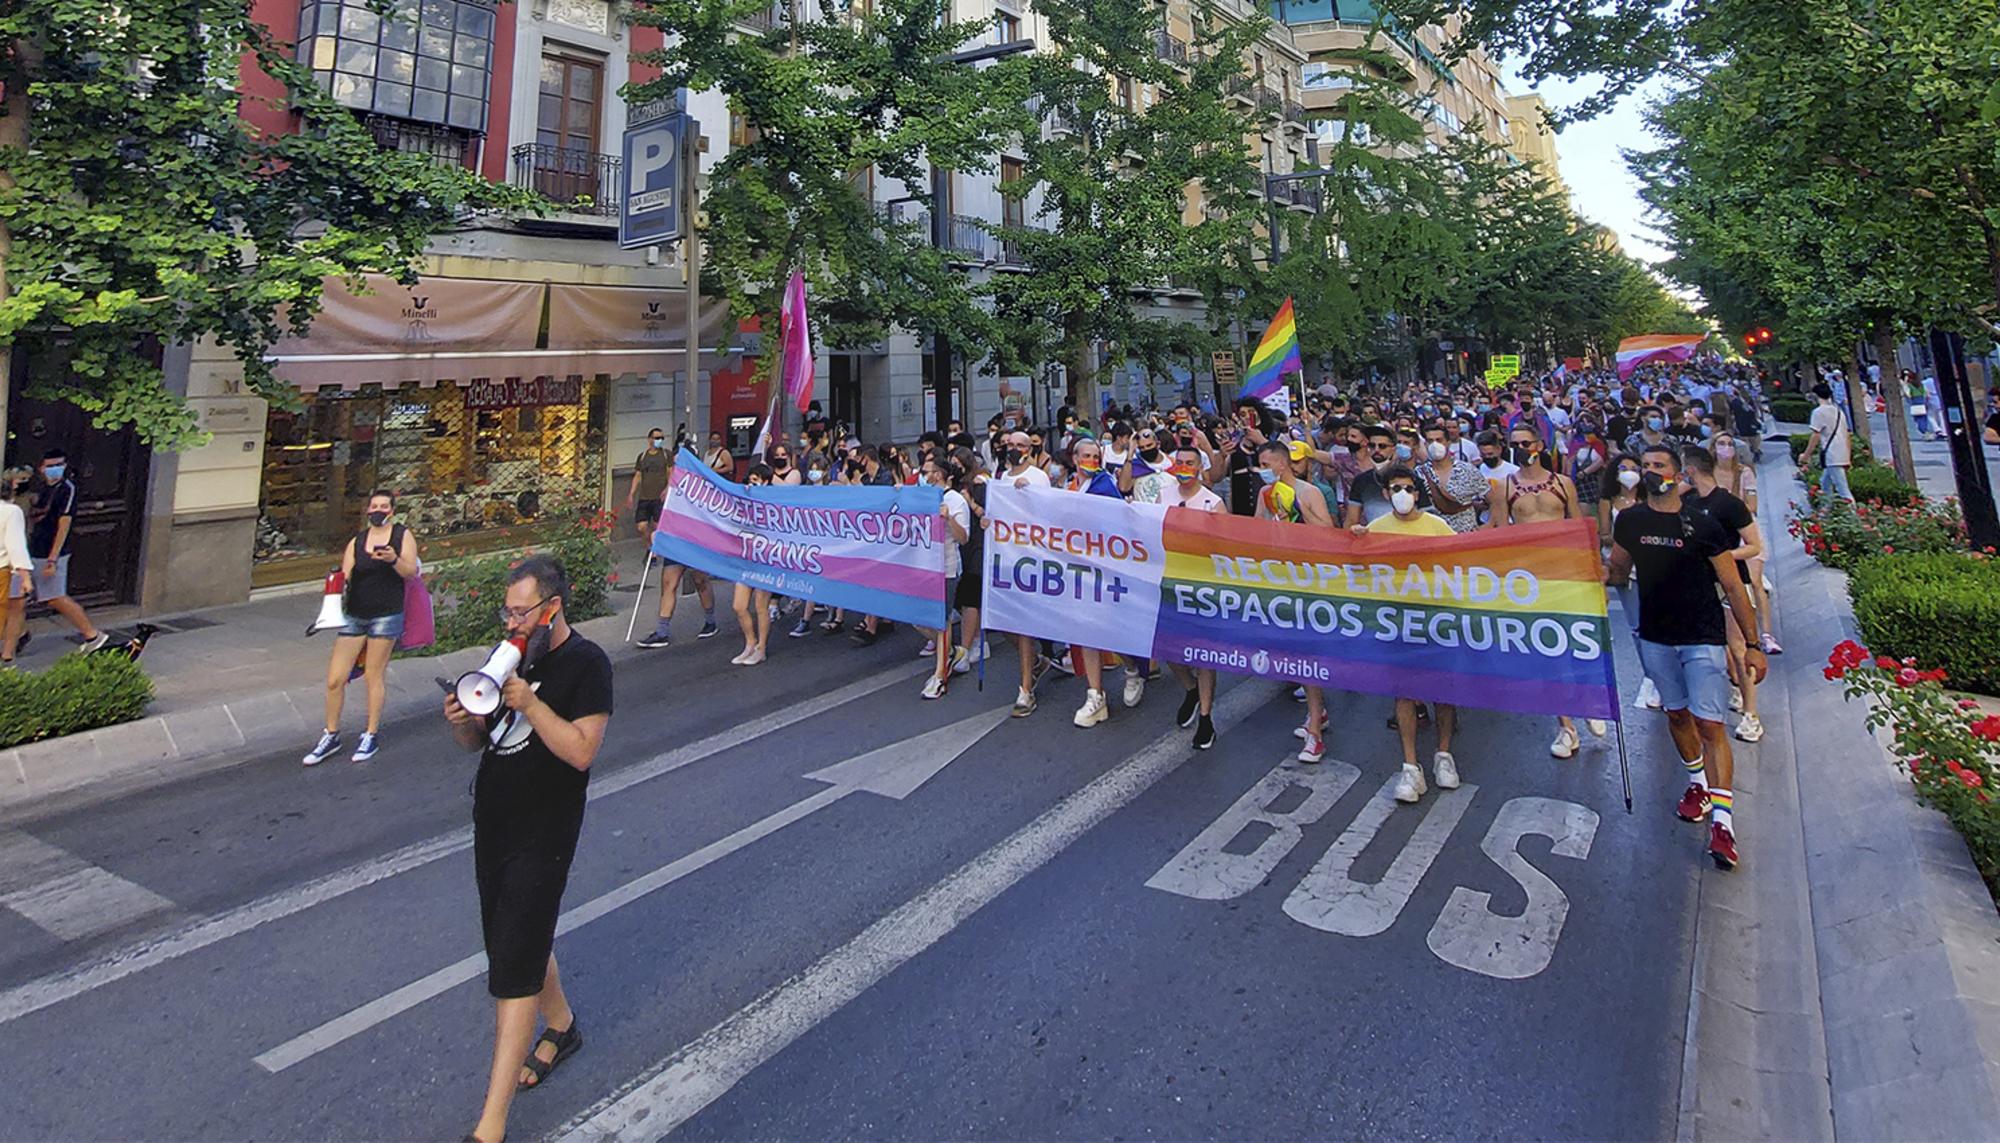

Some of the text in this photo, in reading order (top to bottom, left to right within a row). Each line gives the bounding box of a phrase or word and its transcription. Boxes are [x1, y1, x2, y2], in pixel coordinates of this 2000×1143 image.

[630, 129, 674, 194] P
[401, 308, 438, 319] Minelli
[675, 471, 933, 549] AUTODETERMINACIÓN
[737, 530, 823, 575] TRANS
[993, 519, 1149, 563] DERECHOS
[1640, 535, 1684, 548] ORGULLO
[741, 569, 815, 595] granada visible
[992, 553, 1128, 603] LGBTI+
[1209, 553, 1540, 606] RECUPERANDO
[1174, 584, 1601, 661] ESPACIOS SEGUROS
[1184, 646, 1330, 681] granada visible
[1143, 752, 1601, 980] BUS
